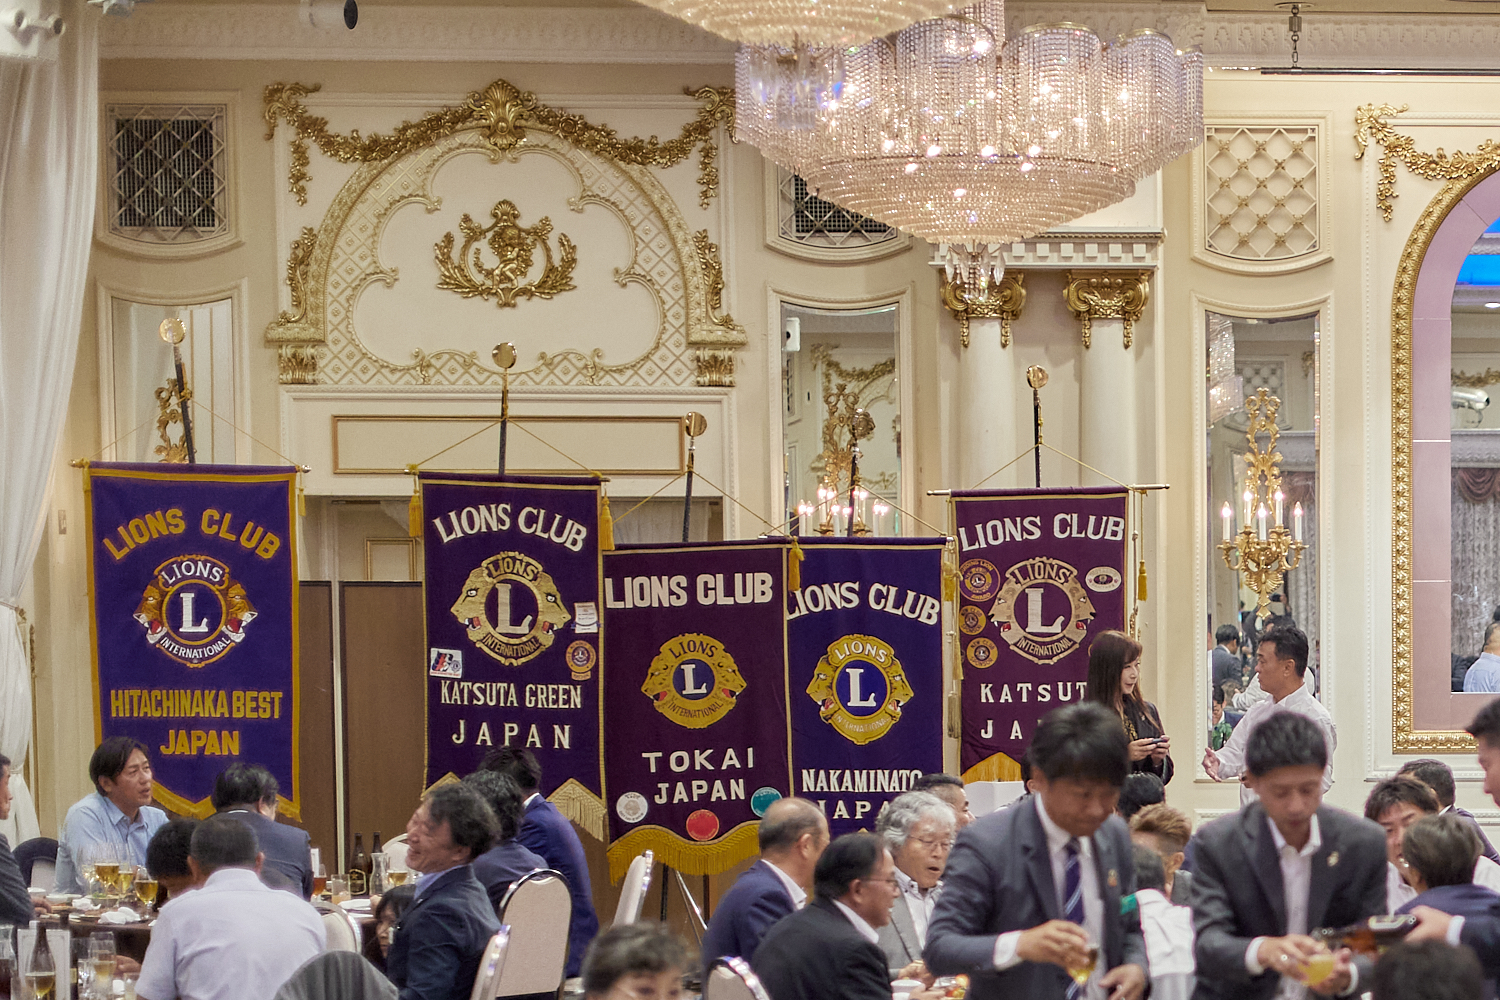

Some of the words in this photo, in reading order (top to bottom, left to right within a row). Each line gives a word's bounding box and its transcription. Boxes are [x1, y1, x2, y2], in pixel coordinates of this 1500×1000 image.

[103, 508, 186, 561] LIONS
[201, 508, 281, 560] CLUB
[432, 503, 511, 544] LIONS
[518, 506, 588, 552] CLUB
[958, 515, 1042, 552] LIONS
[1053, 513, 1125, 541] CLUB
[160, 561, 223, 585] LIONS
[487, 556, 537, 582] LIONS
[1013, 562, 1072, 584] LIONS
[605, 575, 688, 609] LIONS
[696, 572, 773, 605] CLUB
[868, 582, 941, 625] CLUB
[179, 592, 209, 632] L
[495, 583, 532, 634] L
[1025, 587, 1065, 633] L
[160, 637, 231, 659] INTERNATIONAL
[484, 633, 542, 657] INTERNATIONAL
[668, 638, 718, 659] LIONS
[834, 640, 887, 664] LIONS
[1016, 638, 1074, 657] INTERNATIONAL
[681, 664, 707, 695] L
[845, 668, 877, 707] L
[980, 681, 1088, 703] KATSUT
[110, 689, 229, 718] HITACHINAKA
[232, 692, 282, 719] BEST
[441, 680, 518, 707] KATSUTA
[525, 684, 582, 709] GREEN
[667, 695, 724, 719] INTERNATIONAL
[452, 719, 571, 749] JAPAN
[833, 713, 890, 733] INTERNATIONAL
[160, 730, 239, 755] JAPAN
[642, 747, 754, 773] TOKAI
[654, 778, 746, 805] JAPAN
